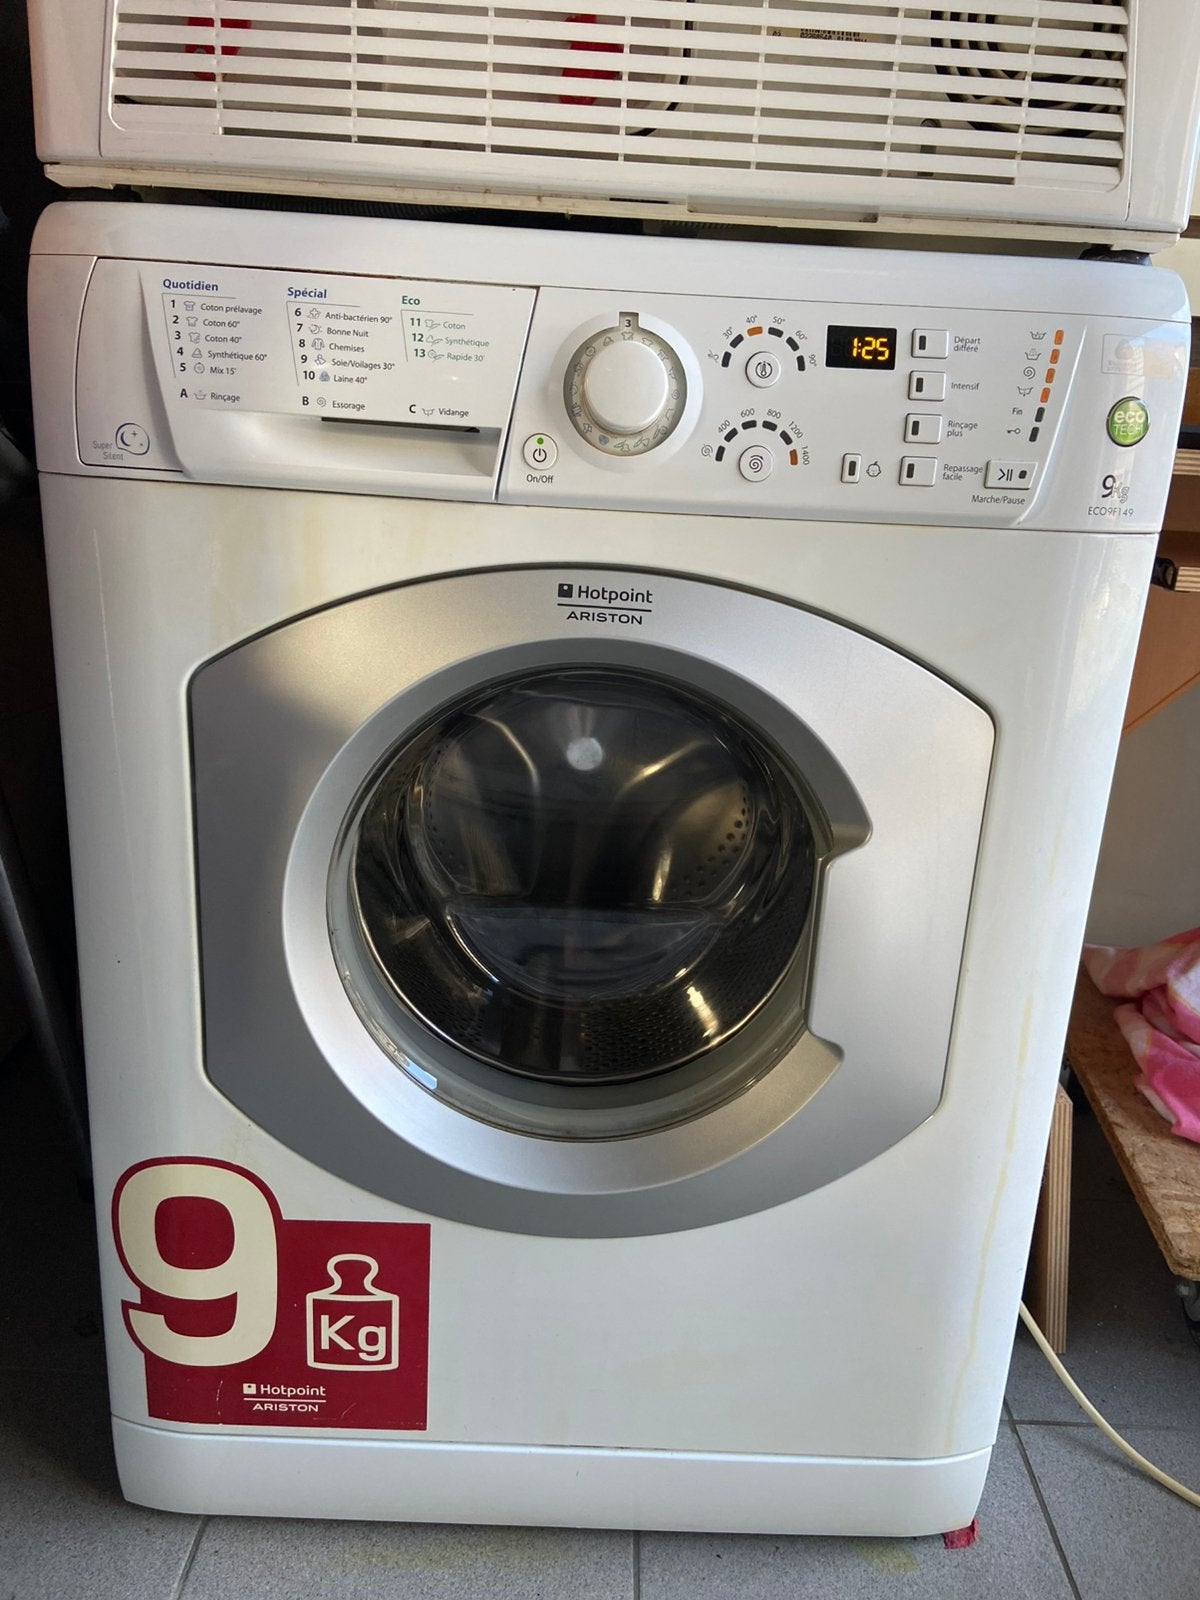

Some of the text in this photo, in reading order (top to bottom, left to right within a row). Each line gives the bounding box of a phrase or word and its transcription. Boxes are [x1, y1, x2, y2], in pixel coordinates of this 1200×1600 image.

[163, 279, 219, 291] Quotidien
[288, 287, 327, 298] Spécial
[402, 296, 420, 305] Eco
[171, 300, 263, 315] 1 Coton prélavage
[173, 315, 179, 324] 2
[203, 318, 226, 327] Coton
[295, 308, 302, 316] 6
[325, 312, 378, 323] Anti-bactérien
[746, 315, 758, 324] 40°
[772, 316, 786, 325] 50°
[297, 323, 303, 332] 7
[327, 327, 351, 336] Bonne
[410, 318, 466, 330] 11 Coton
[625, 319, 631, 328] 3
[175, 331, 181, 340] 3
[205, 334, 228, 343] Coton
[723, 326, 733, 339] 30°
[795, 330, 808, 340] 60°
[299, 339, 365, 352] 8 Chemises
[412, 333, 490, 347] 12 Synthétique
[954, 336, 981, 346] Départ
[177, 347, 268, 361] 4 Synthétique 60°
[414, 348, 426, 358] 13
[447, 353, 472, 362] Rapide
[853, 337, 889, 361] 1:25
[301, 354, 308, 363] 9
[332, 359, 381, 371] Soie/Voilages
[808, 354, 817, 367] 90°
[180, 363, 186, 372] 5
[210, 366, 224, 374] Mix
[303, 371, 315, 380] 10
[334, 375, 354, 383] Laine
[951, 382, 980, 390] Intensif
[180, 388, 240, 403] A Rinçage
[302, 396, 365, 411] B Essorage
[409, 404, 469, 418] C Vidange
[740, 408, 755, 418] 600
[766, 408, 782, 420] 800
[1012, 407, 1023, 415] Fin
[1114, 410, 1146, 423] eco
[718, 420, 731, 433] 400
[788, 421, 803, 439] 1200
[948, 420, 978, 431] Rinçage
[801, 446, 810, 465] 1400
[943, 464, 984, 474] Repassage
[526, 474, 554, 483] On/Off
[942, 472, 963, 481] facile
[971, 495, 1026, 505] Marche/Pause
[578, 585, 653, 604] Hotpoint
[566, 611, 643, 625] ARISTON
[118, 1164, 278, 1367] 9
[320, 1314, 387, 1362] Kg
[260, 1384, 326, 1397] Hotpoint
[252, 1403, 319, 1412] ARISTON
